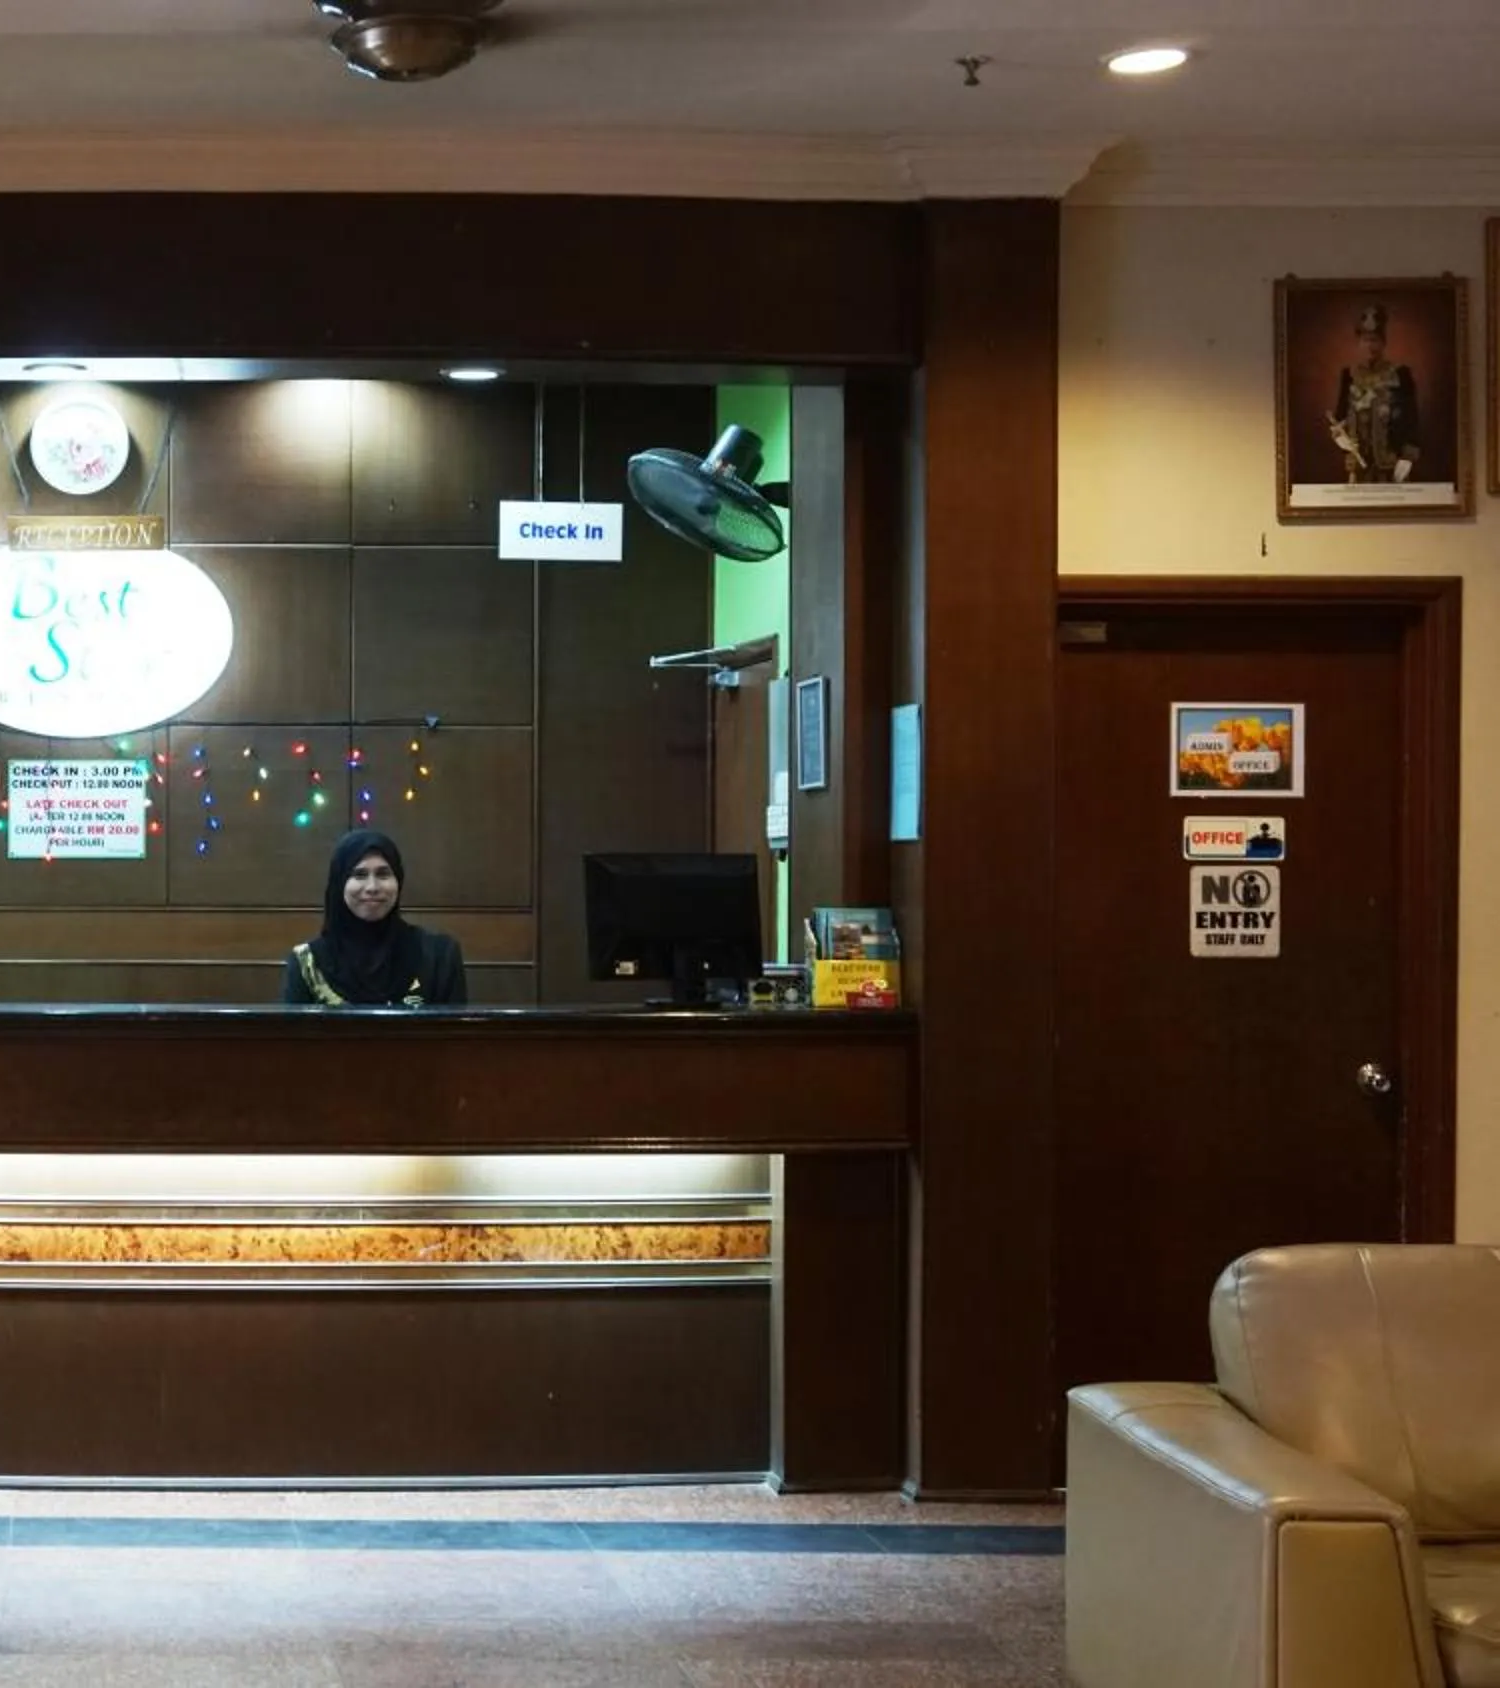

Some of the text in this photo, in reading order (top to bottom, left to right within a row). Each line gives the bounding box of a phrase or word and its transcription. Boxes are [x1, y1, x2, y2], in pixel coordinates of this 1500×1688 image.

[13, 522, 158, 549] RECEPTION
[519, 521, 604, 540] Check In
[10, 554, 138, 621] Best
[12, 765, 60, 777] CHECK
[64, 765, 80, 777] IN
[91, 765, 120, 777] 3.00
[11, 779, 48, 790] CHECK
[50, 779, 73, 790] OUT
[111, 779, 144, 790] NOON
[25, 799, 129, 809] LATE CHECK OUT
[29, 811, 65, 821] (ATER
[95, 811, 126, 821] NOON
[1191, 831, 1245, 846] OFFICE
[1195, 911, 1277, 930] ENTRY
[1205, 933, 1266, 946] STAFF ONLY
